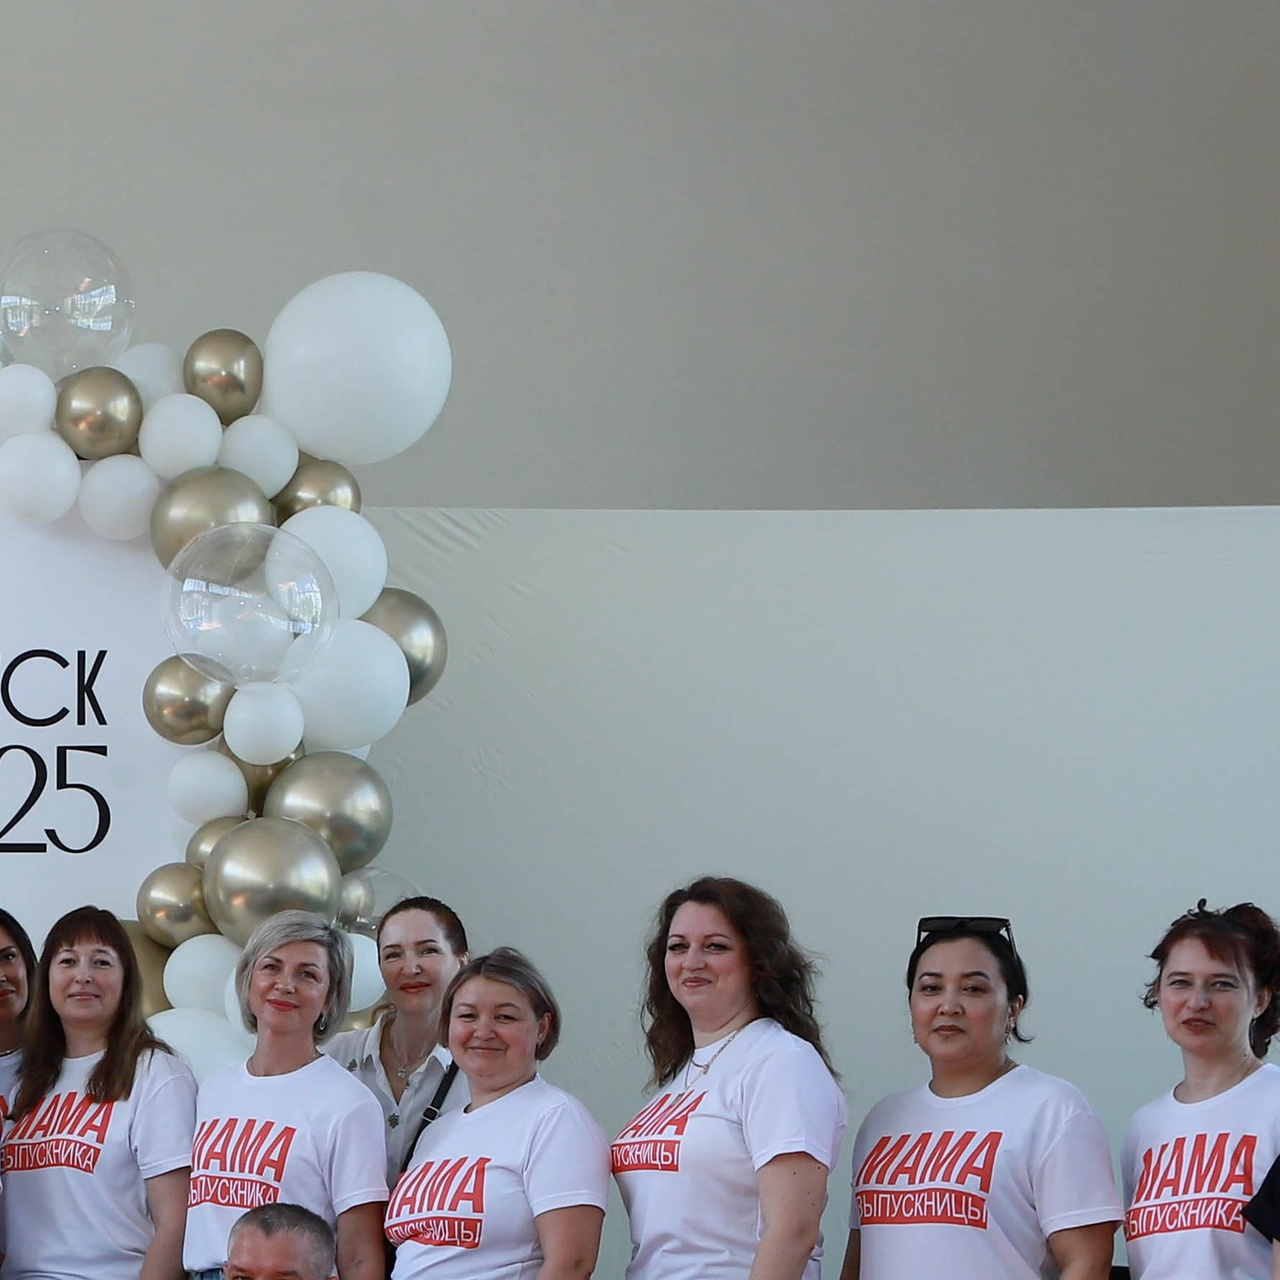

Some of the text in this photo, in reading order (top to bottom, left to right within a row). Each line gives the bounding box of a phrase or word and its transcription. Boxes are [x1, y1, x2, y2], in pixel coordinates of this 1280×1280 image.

[615, 1089, 710, 1140] АМА
[855, 1130, 1004, 1194] МАМА
[188, 1177, 275, 1207] ЫПУСКНИКА
